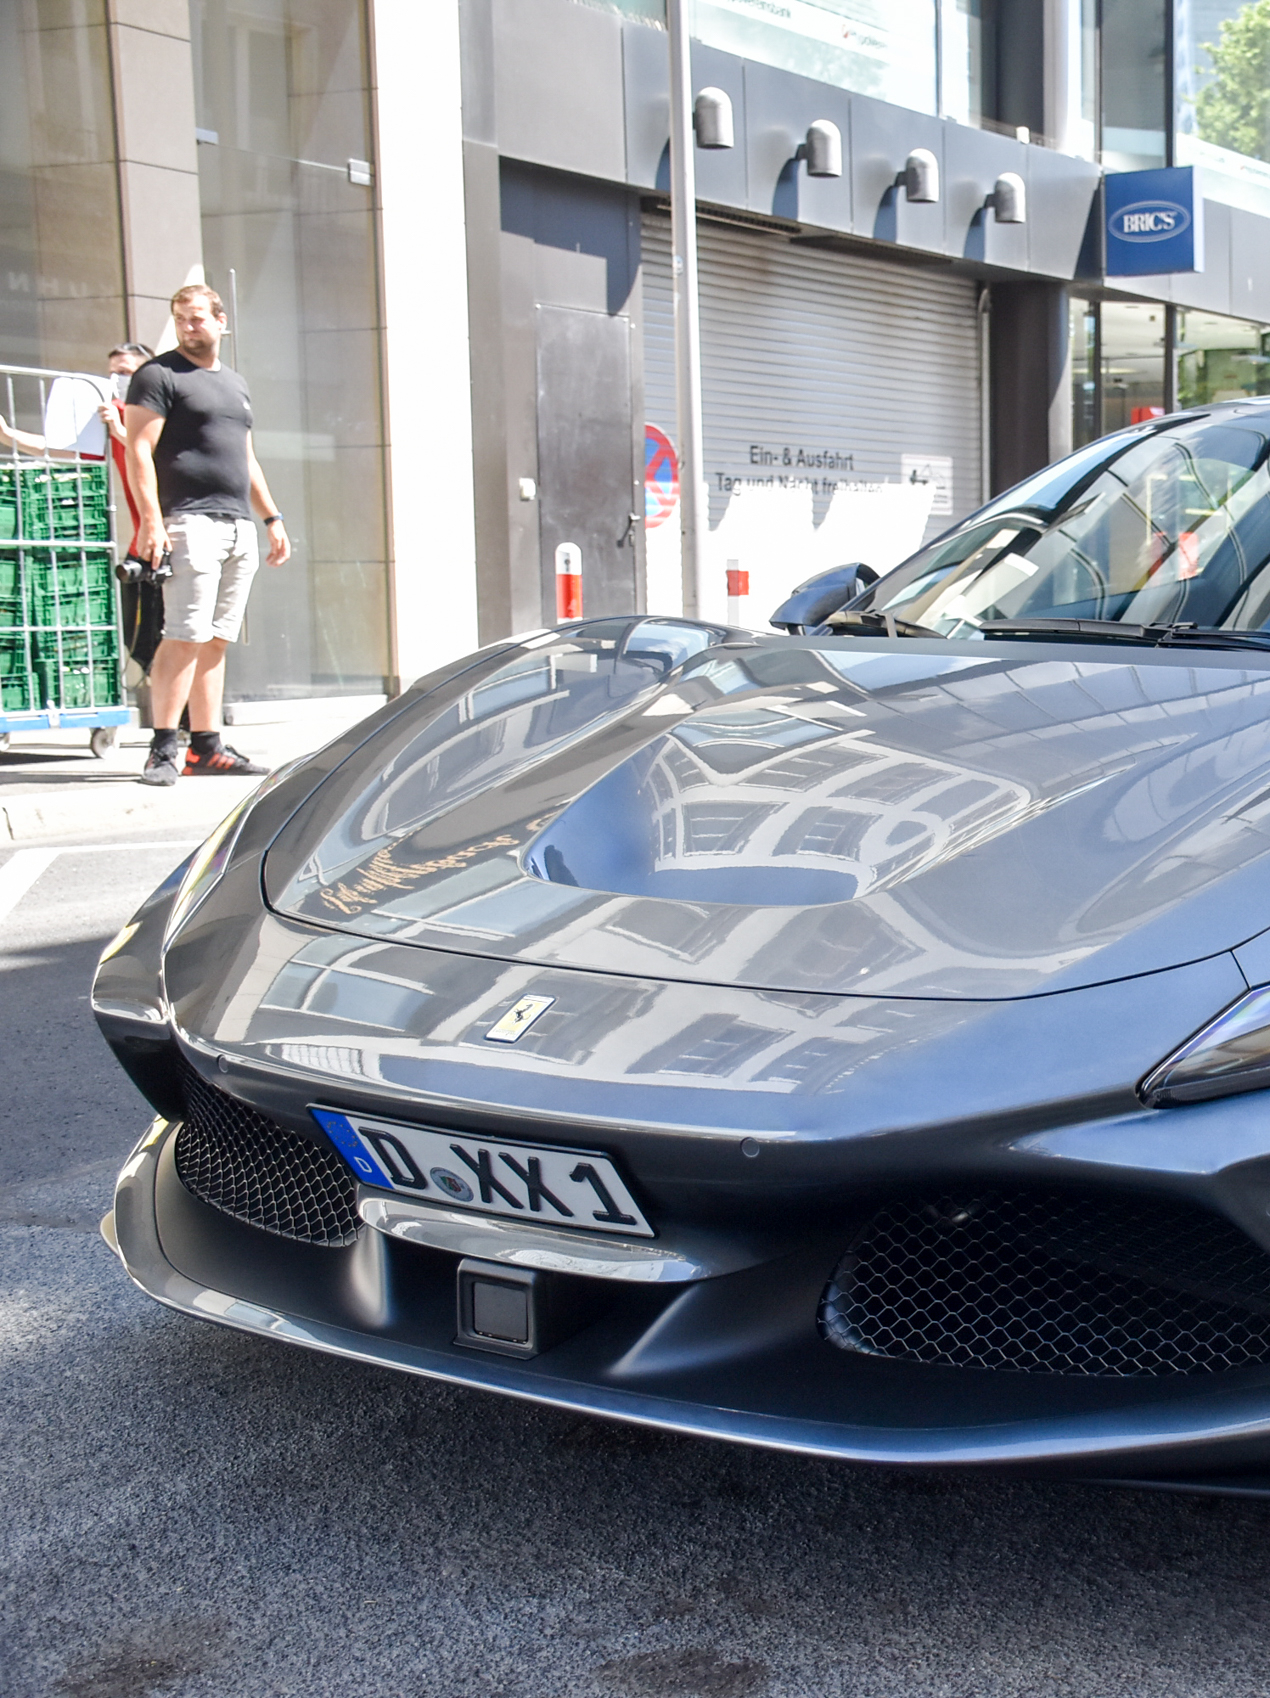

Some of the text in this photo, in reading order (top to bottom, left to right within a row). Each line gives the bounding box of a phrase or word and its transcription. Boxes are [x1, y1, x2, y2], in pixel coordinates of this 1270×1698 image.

[750, 445, 854, 471] Ein- & Ausfahrt
[354, 1156, 372, 1173] D
[357, 1126, 429, 1190] D
